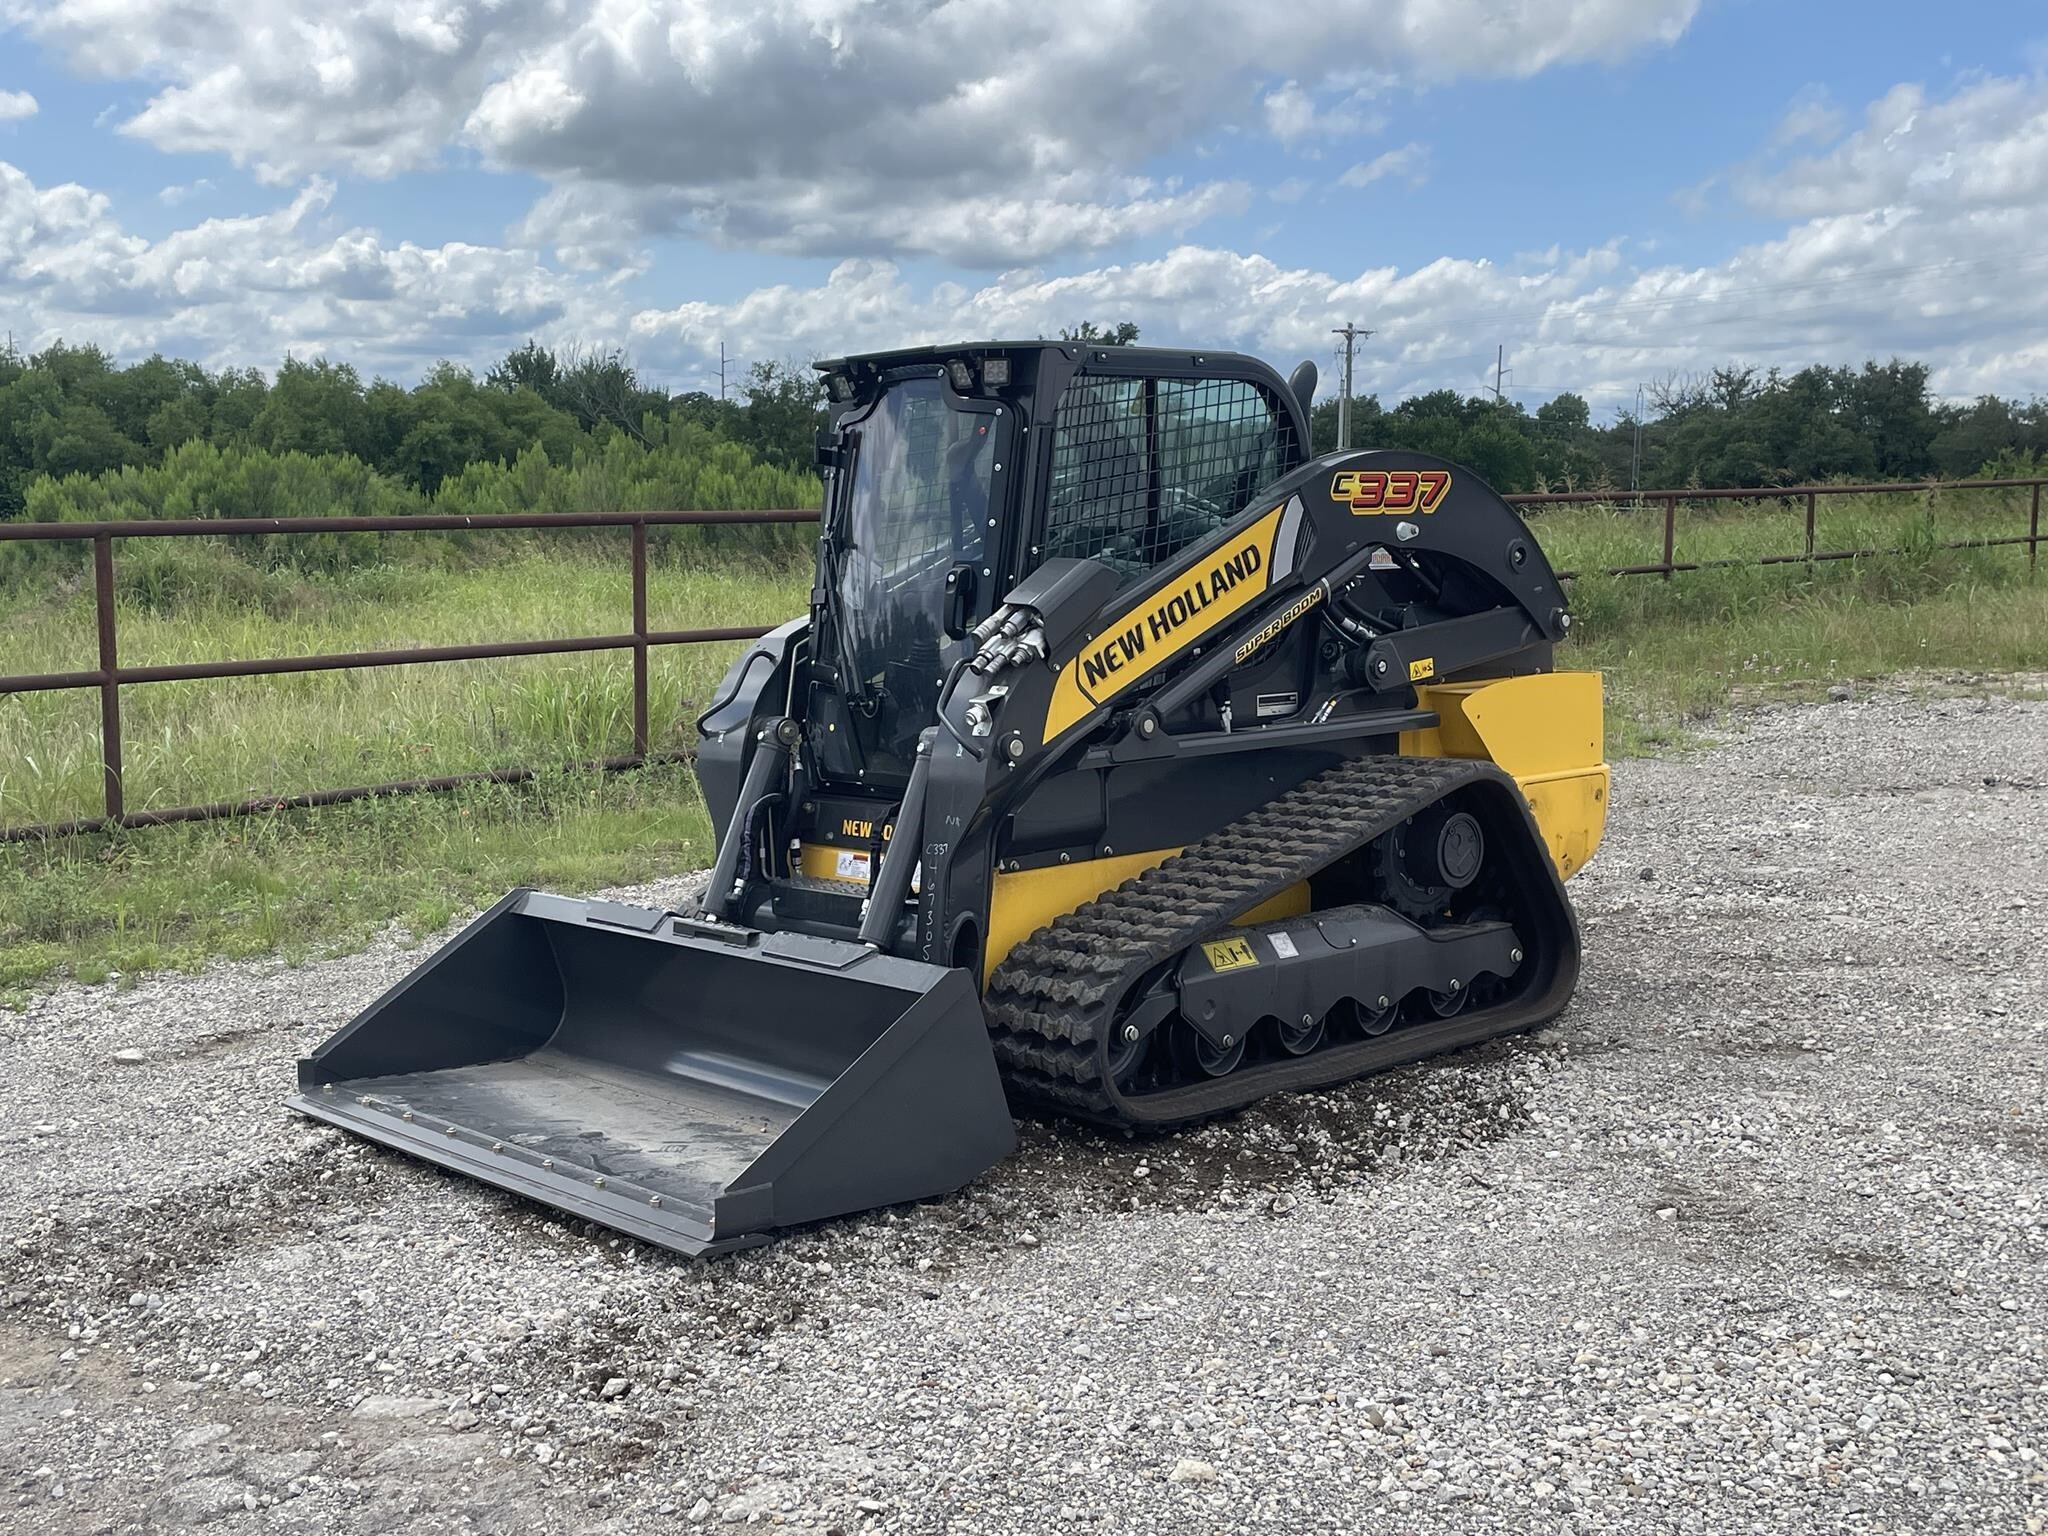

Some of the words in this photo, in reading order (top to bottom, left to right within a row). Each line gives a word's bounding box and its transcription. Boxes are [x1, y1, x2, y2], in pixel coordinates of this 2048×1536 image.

[1331, 471, 1452, 515] C337
[1082, 622, 1146, 689] NEW
[1147, 543, 1261, 643] HOLLAND
[1235, 619, 1281, 664] SUPER
[1281, 587, 1321, 628] BOOM
[842, 819, 873, 838] NEW
[926, 843, 949, 855] C337
